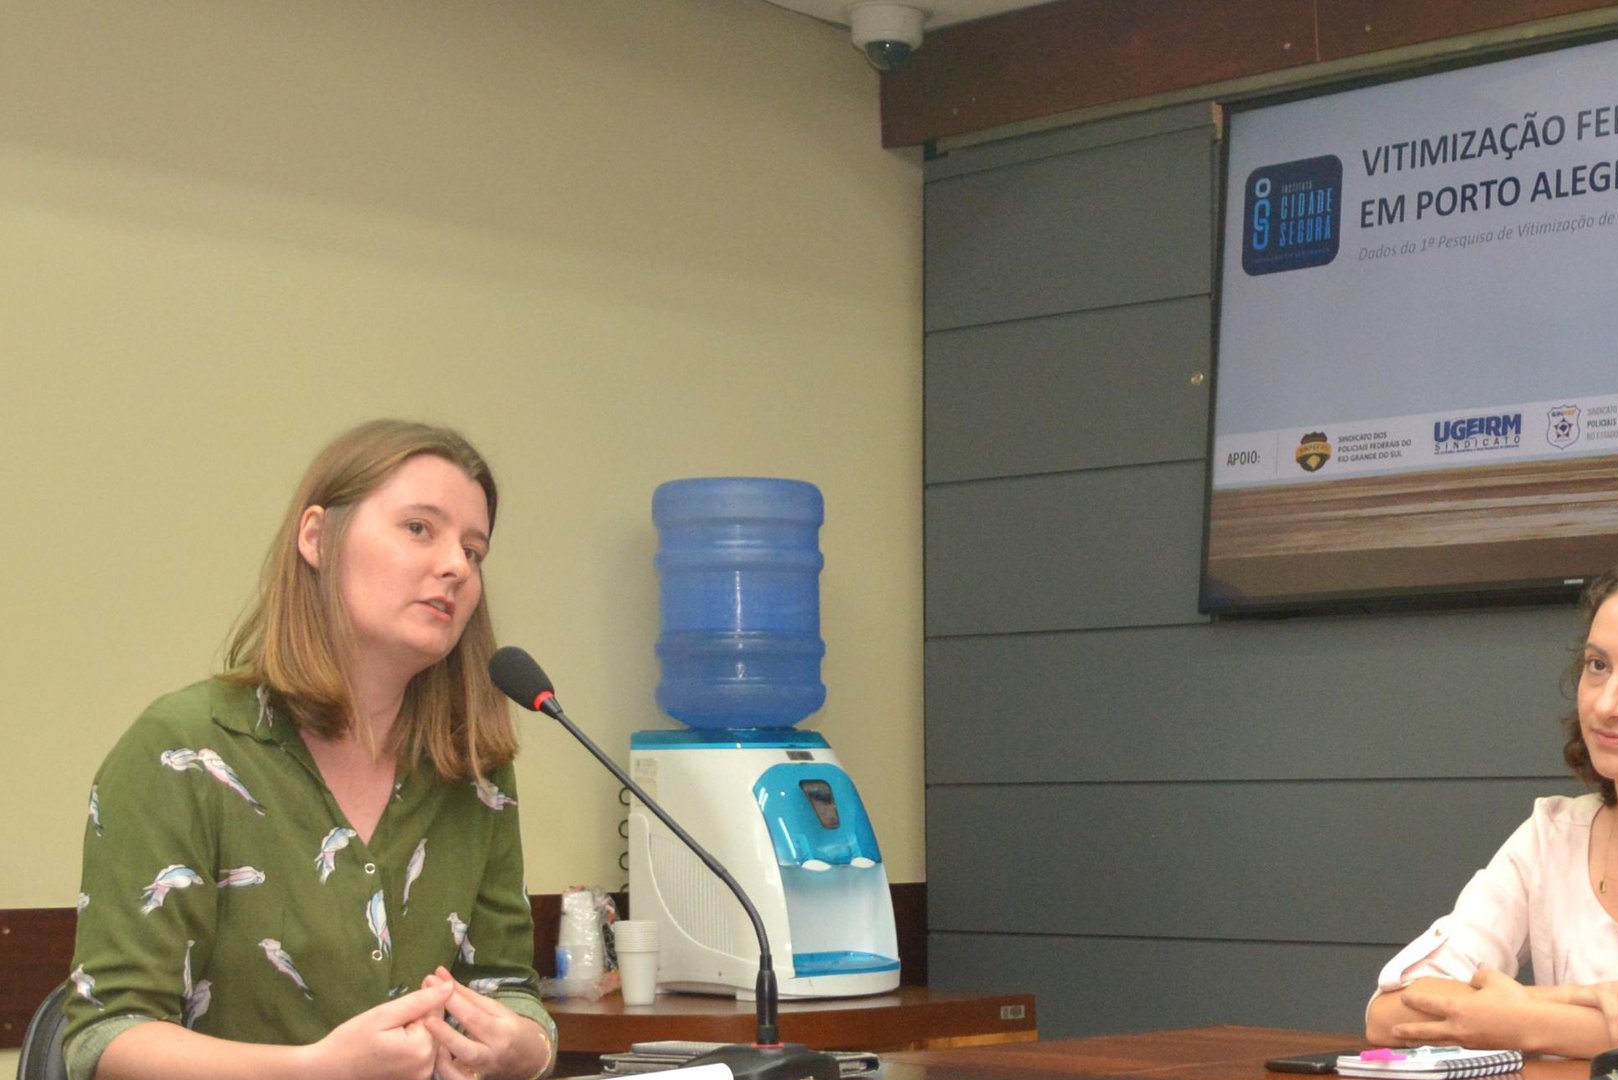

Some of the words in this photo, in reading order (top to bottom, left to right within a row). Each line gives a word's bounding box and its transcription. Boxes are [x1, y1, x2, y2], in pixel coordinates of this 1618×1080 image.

[1362, 112, 1566, 177] VITIMIZAÇÃO
[1280, 187, 1333, 220] CIDADE
[1359, 194, 1405, 229] EM
[1415, 177, 1521, 220] PORTO
[1279, 215, 1331, 247] SEGURA
[1358, 243, 1397, 262] Dados
[1438, 230, 1494, 250] Pesquisa
[1497, 226, 1513, 241] de
[1518, 214, 1595, 237] Vitimização
[1599, 211, 1615, 226] de
[1338, 432, 1372, 443] SINDICATO
[1373, 431, 1387, 440] DOS
[1433, 413, 1522, 442] UGEIRM
[1337, 443, 1368, 453] POLICIAIS
[1369, 440, 1400, 450] FEDERAIS
[1401, 439, 1412, 447] DO
[1337, 455, 1349, 463] RIO
[1350, 453, 1377, 462] GRANDE
[1378, 451, 1389, 459] DO
[1390, 450, 1402, 459] SUL
[1434, 435, 1521, 452] SINDICATO
[1226, 450, 1260, 467] APOIO:
